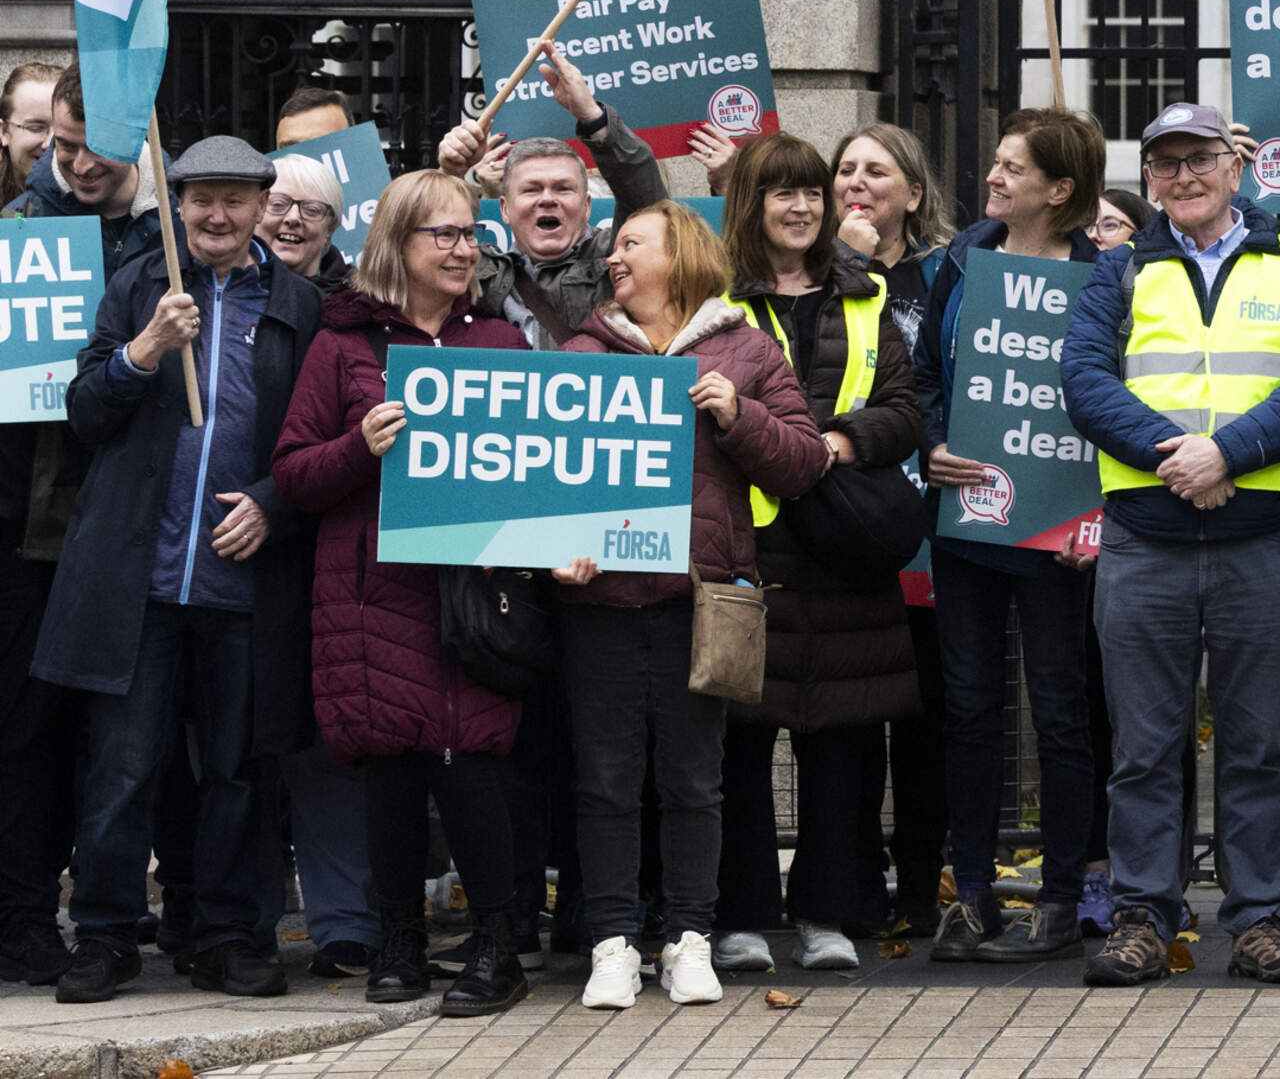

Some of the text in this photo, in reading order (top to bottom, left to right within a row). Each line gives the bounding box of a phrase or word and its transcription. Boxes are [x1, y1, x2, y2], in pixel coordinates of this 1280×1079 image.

[636, 15, 715, 48] Work
[630, 52, 758, 85] Services
[1246, 52, 1271, 78] a
[718, 104, 754, 115] BETTER
[720, 115, 744, 123] DEAL
[1003, 272, 1068, 314] We
[403, 366, 682, 425] OFFICIAL
[967, 375, 993, 402] a
[408, 430, 671, 487] DISPUTE
[968, 496, 994, 506] DEAL
[969, 487, 1007, 499] BETTER
[603, 519, 671, 561] FÓRSA
